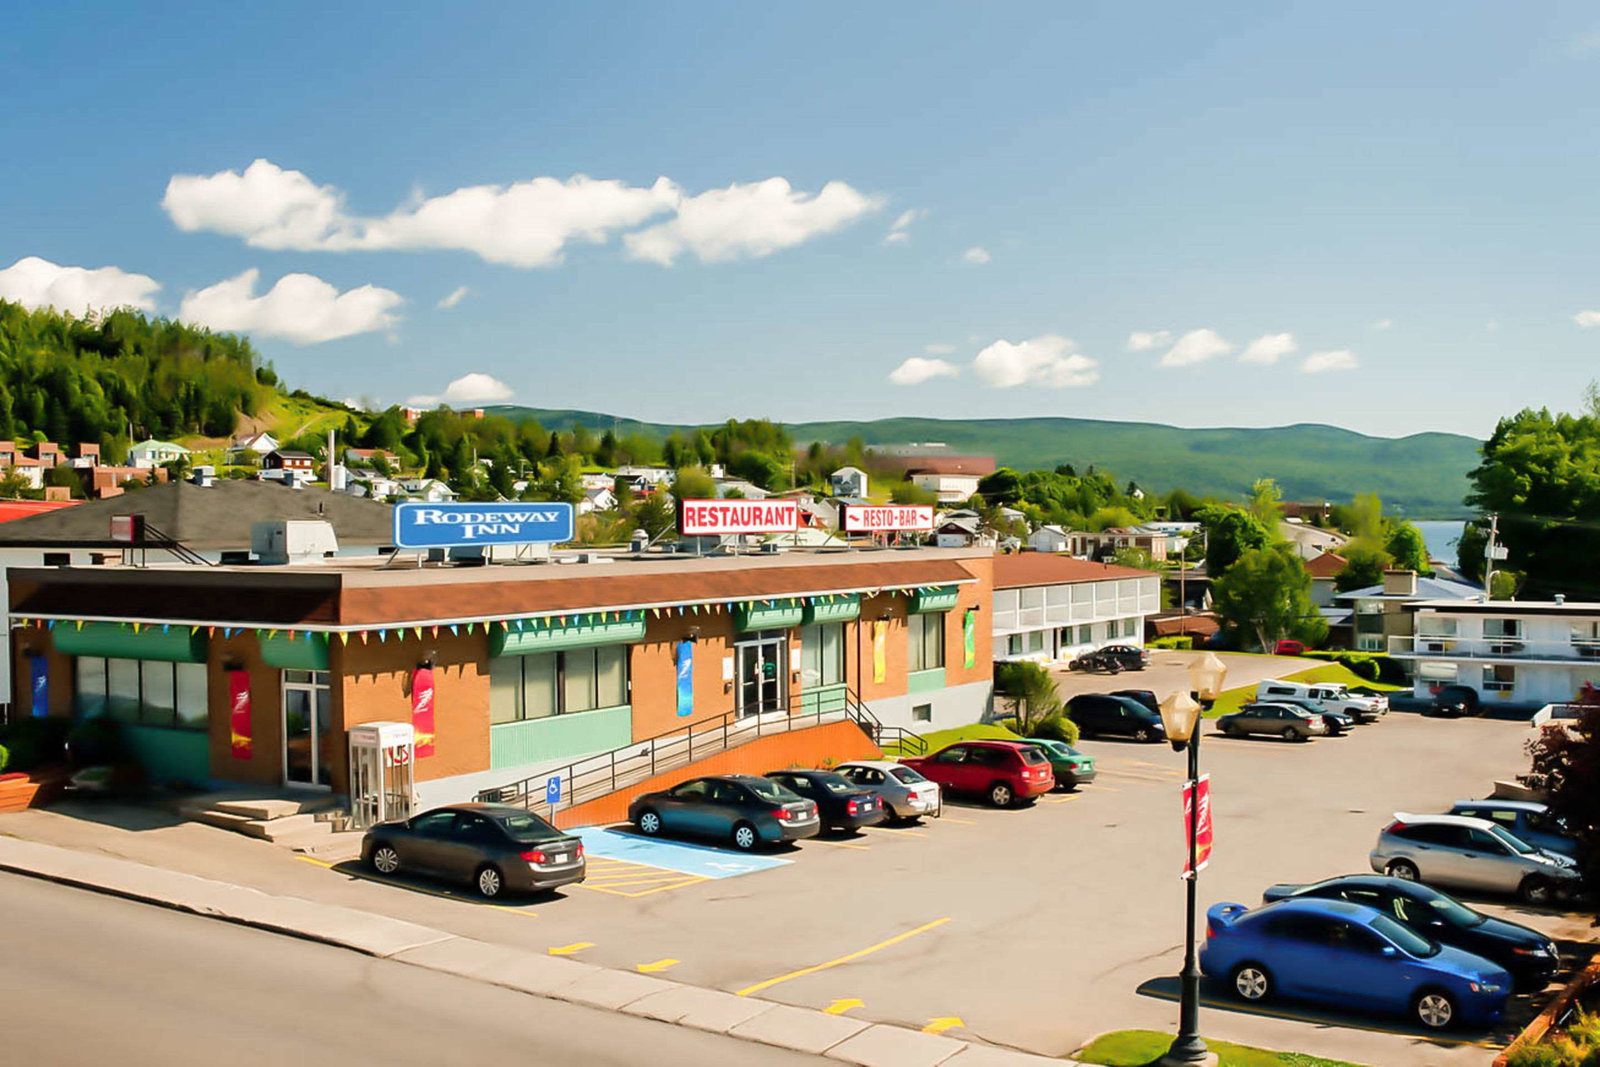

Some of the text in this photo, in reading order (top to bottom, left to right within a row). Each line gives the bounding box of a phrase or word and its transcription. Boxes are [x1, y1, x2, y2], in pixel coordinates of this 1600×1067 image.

[413, 508, 560, 525] RODEWAY
[685, 506, 795, 527] RESTAURANT
[863, 509, 917, 527] RESTO-BAR
[461, 523, 521, 539] INN
